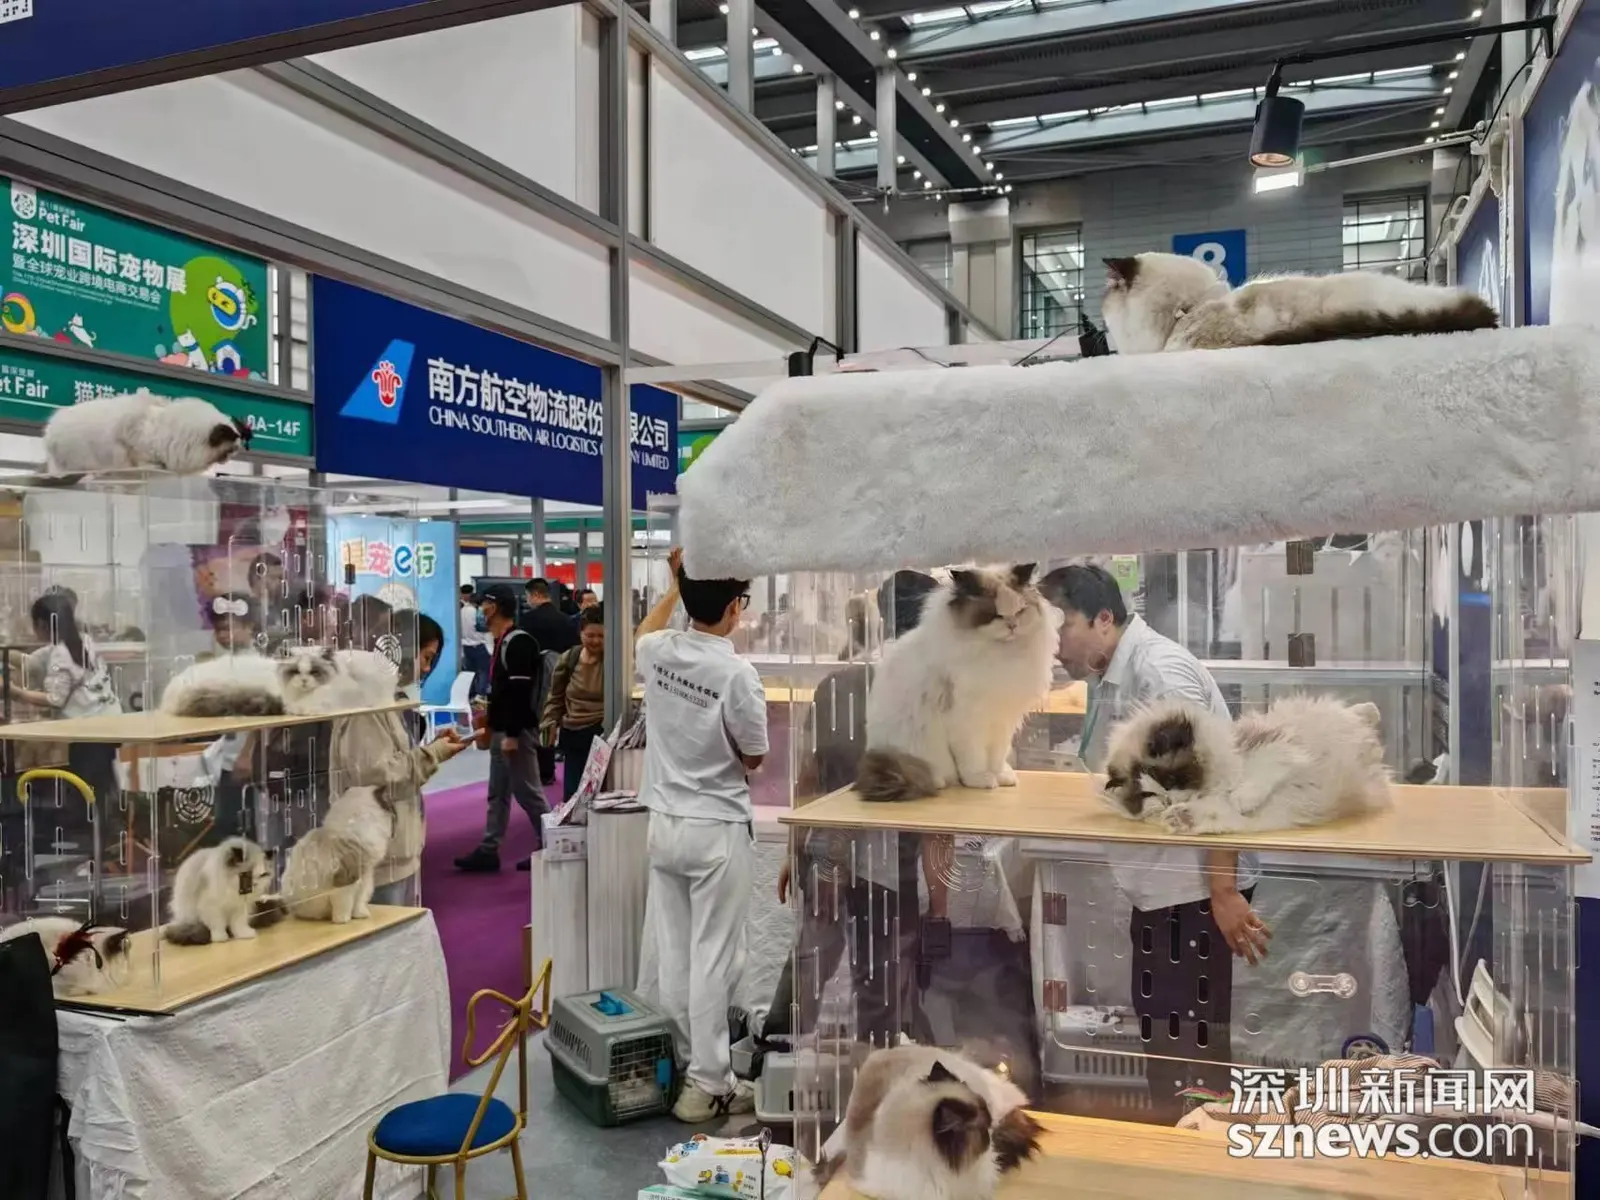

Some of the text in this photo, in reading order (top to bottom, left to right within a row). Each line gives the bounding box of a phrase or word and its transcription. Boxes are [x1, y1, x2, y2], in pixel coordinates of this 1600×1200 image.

[39, 206, 60, 225] Pet
[62, 214, 86, 232] Fair
[12, 221, 187, 294] 深圳国际宠物展
[15, 376, 49, 399] Fair
[427, 357, 669, 452] 南方航空物流股份公司
[429, 405, 470, 430] CHINA
[471, 414, 533, 442] SOUTHERN
[534, 429, 550, 446] AIR
[551, 432, 598, 456] LOGISTICS
[641, 451, 670, 470] LIMITED
